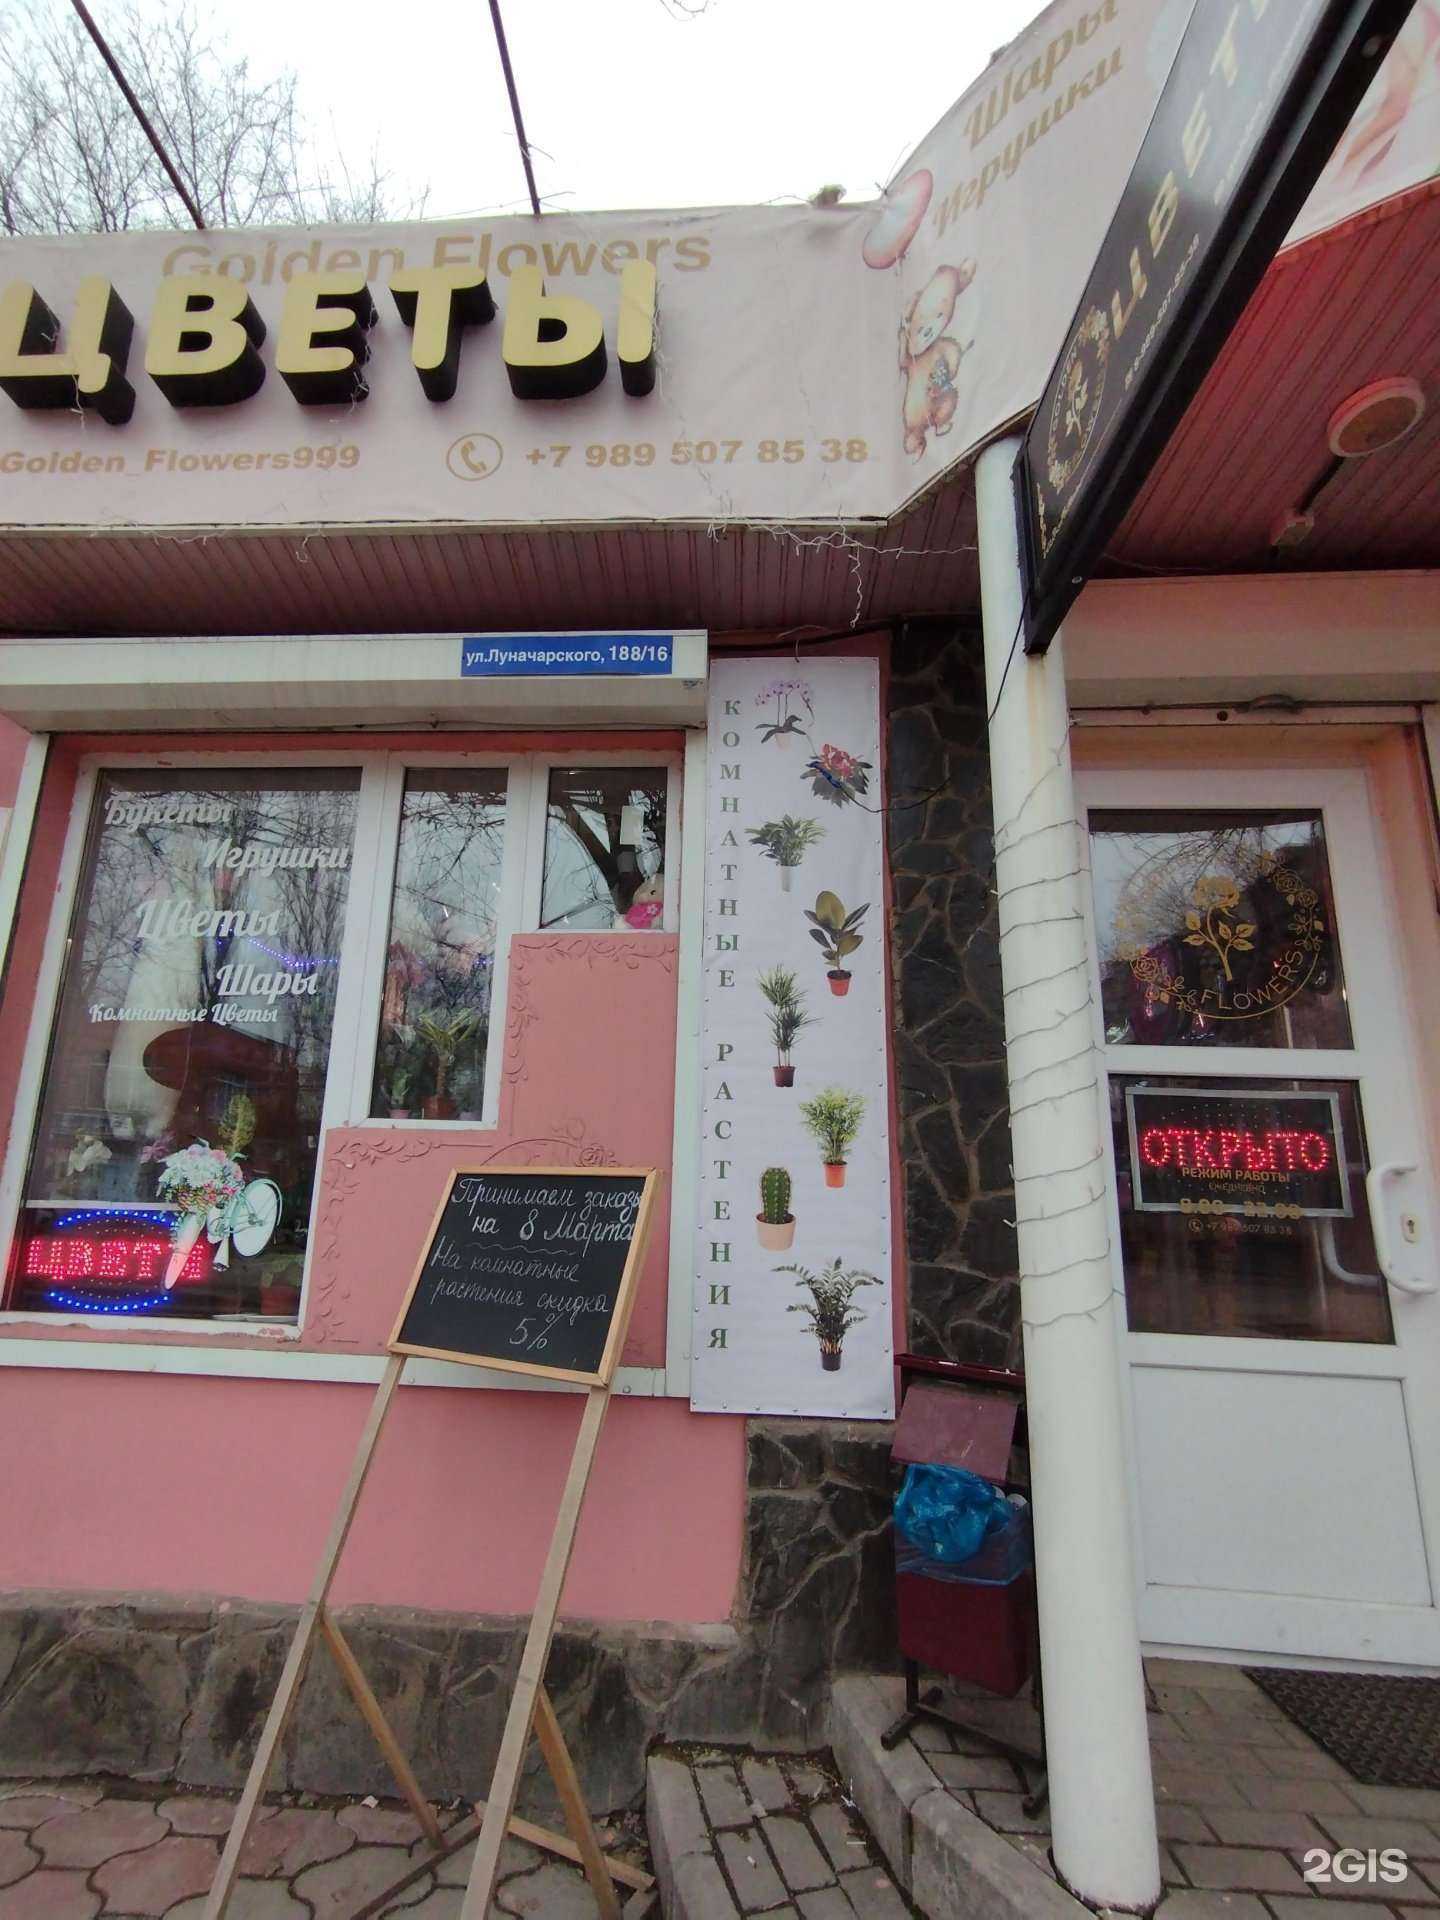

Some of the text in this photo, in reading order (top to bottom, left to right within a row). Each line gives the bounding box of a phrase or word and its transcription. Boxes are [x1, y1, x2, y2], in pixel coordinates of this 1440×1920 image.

[962, 0, 1120, 152] Шары
[932, 46, 1124, 238] Игрушки
[0, 260, 658, 400] ЦВЕТЫ
[526, 438, 868, 467] +7 989 507 85 38
[609, 645, 668, 662] 188/16
[105, 788, 233, 833] Букеты
[203, 838, 351, 877] Игрушки
[715, 699, 742, 988] КОМНАТНЫЕ
[136, 900, 282, 942] Цветы
[216, 964, 319, 1005] Шары
[1199, 945, 1304, 1011] FLOWERS
[88, 1002, 278, 1026] Комнатные Цветы
[1143, 1129, 1329, 1171] ОТКРЫТО
[1182, 1166, 1290, 1183] РЕЖИМ РАБОТЫ
[451, 1177, 576, 1216] Принимаем
[707, 1043, 734, 1349] РАСТЕНИЯ
[431, 1235, 463, 1270] На
[472, 1208, 636, 1258] на 8 Марта
[431, 1278, 609, 1326] растения скидка
[509, 1312, 564, 1350] 5%
